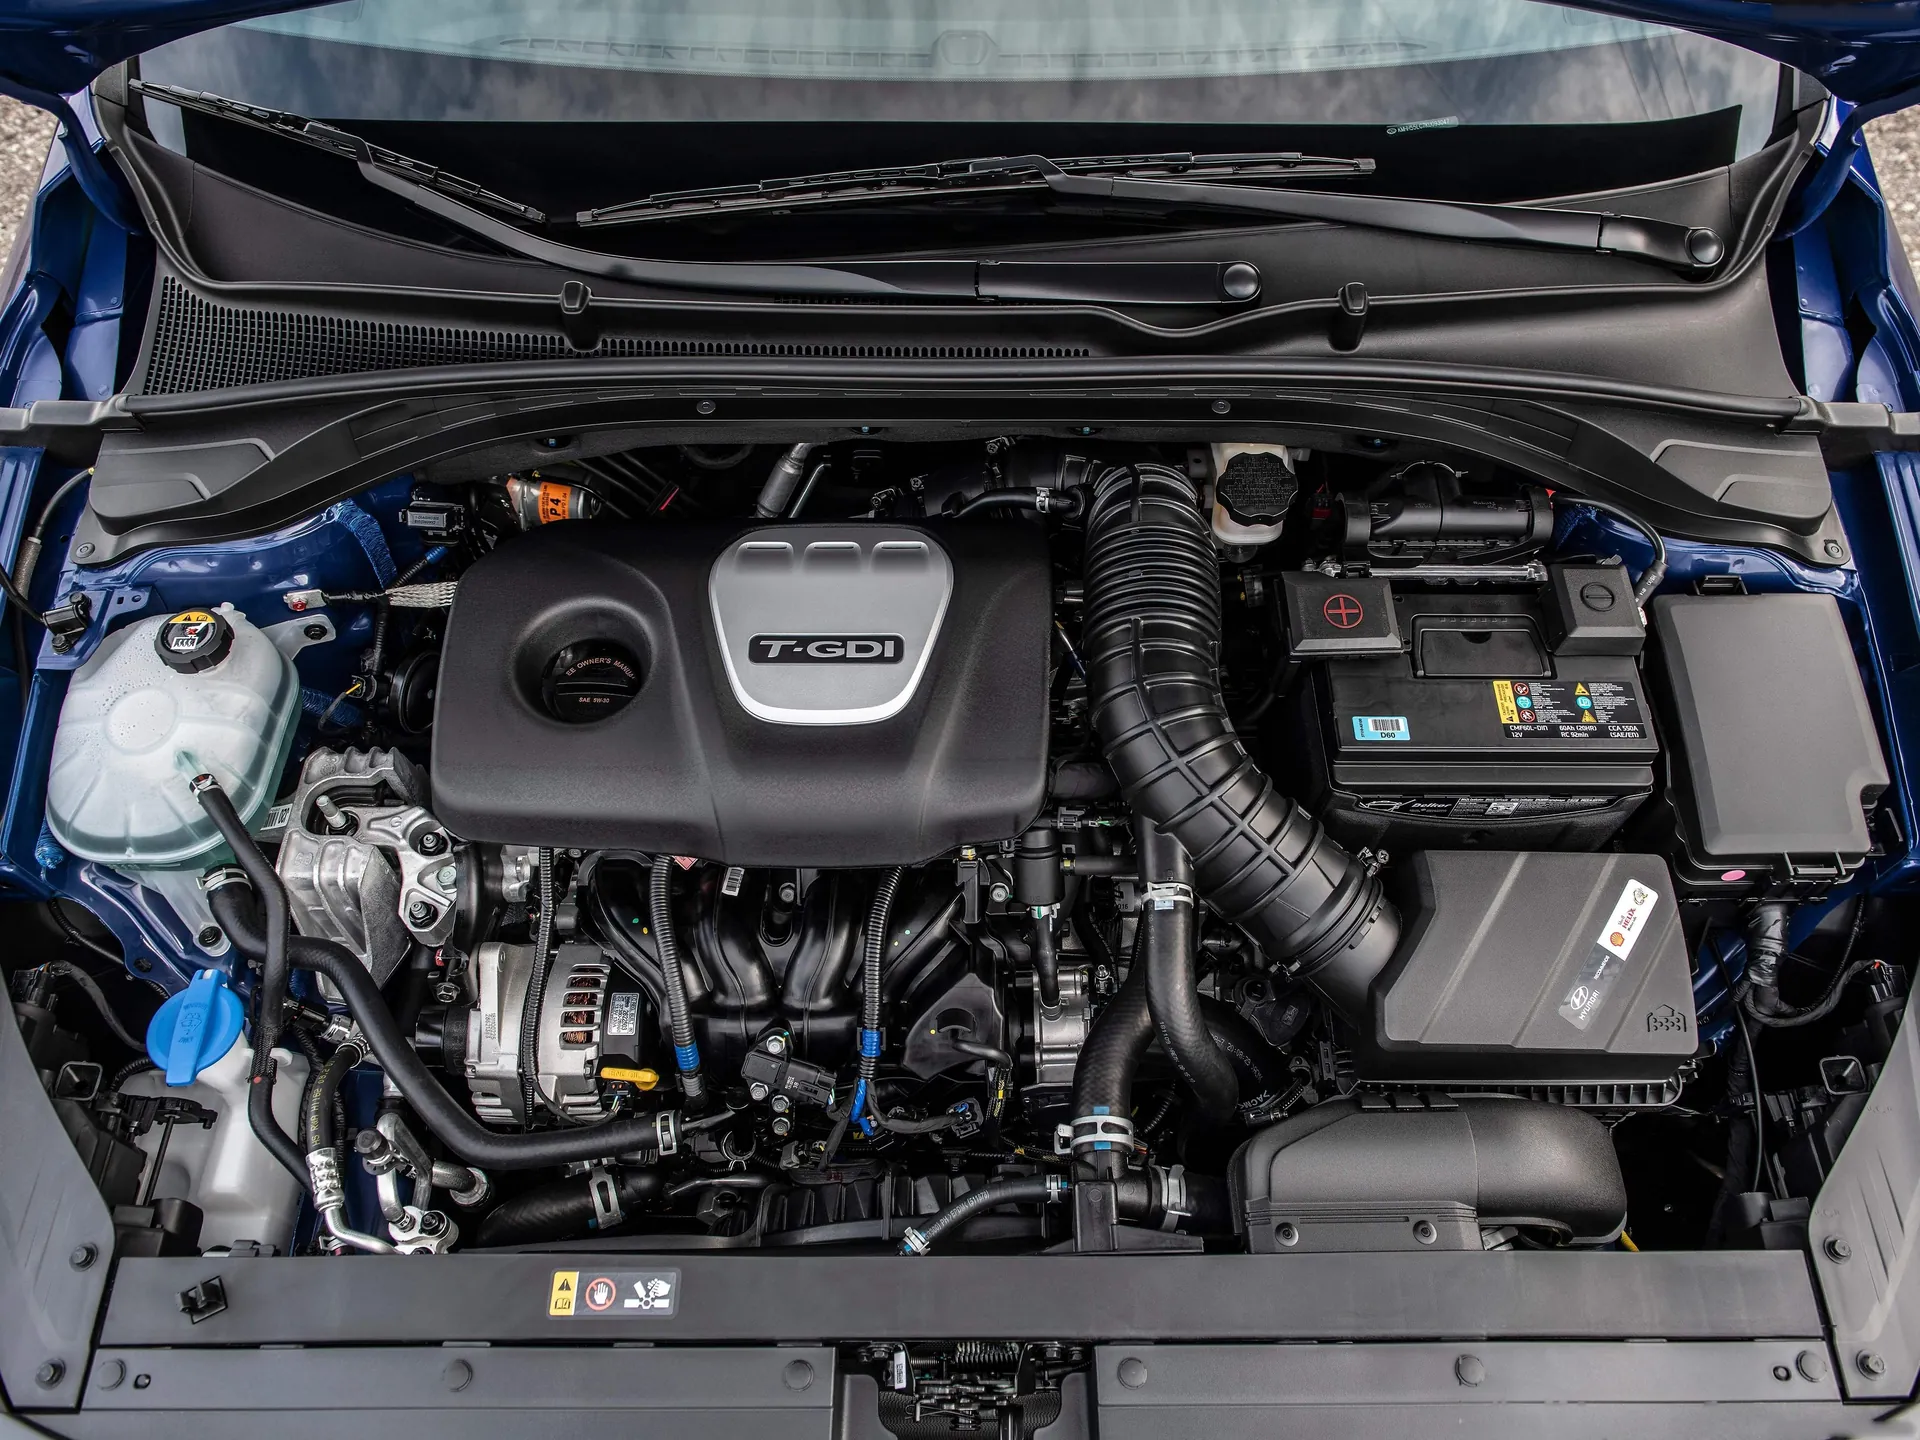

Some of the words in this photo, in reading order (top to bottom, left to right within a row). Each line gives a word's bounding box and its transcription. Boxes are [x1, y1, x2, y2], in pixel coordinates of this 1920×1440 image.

[760, 640, 894, 658] T-GDI
[576, 658, 612, 668] OWNER'S
[1622, 908, 1636, 929] HELIX
[1594, 955, 1610, 980] RECOMMENDS
[1579, 990, 1600, 1021] HYUNDAI
[312, 1134, 320, 1146] HS
[941, 1214, 949, 1227] PH
